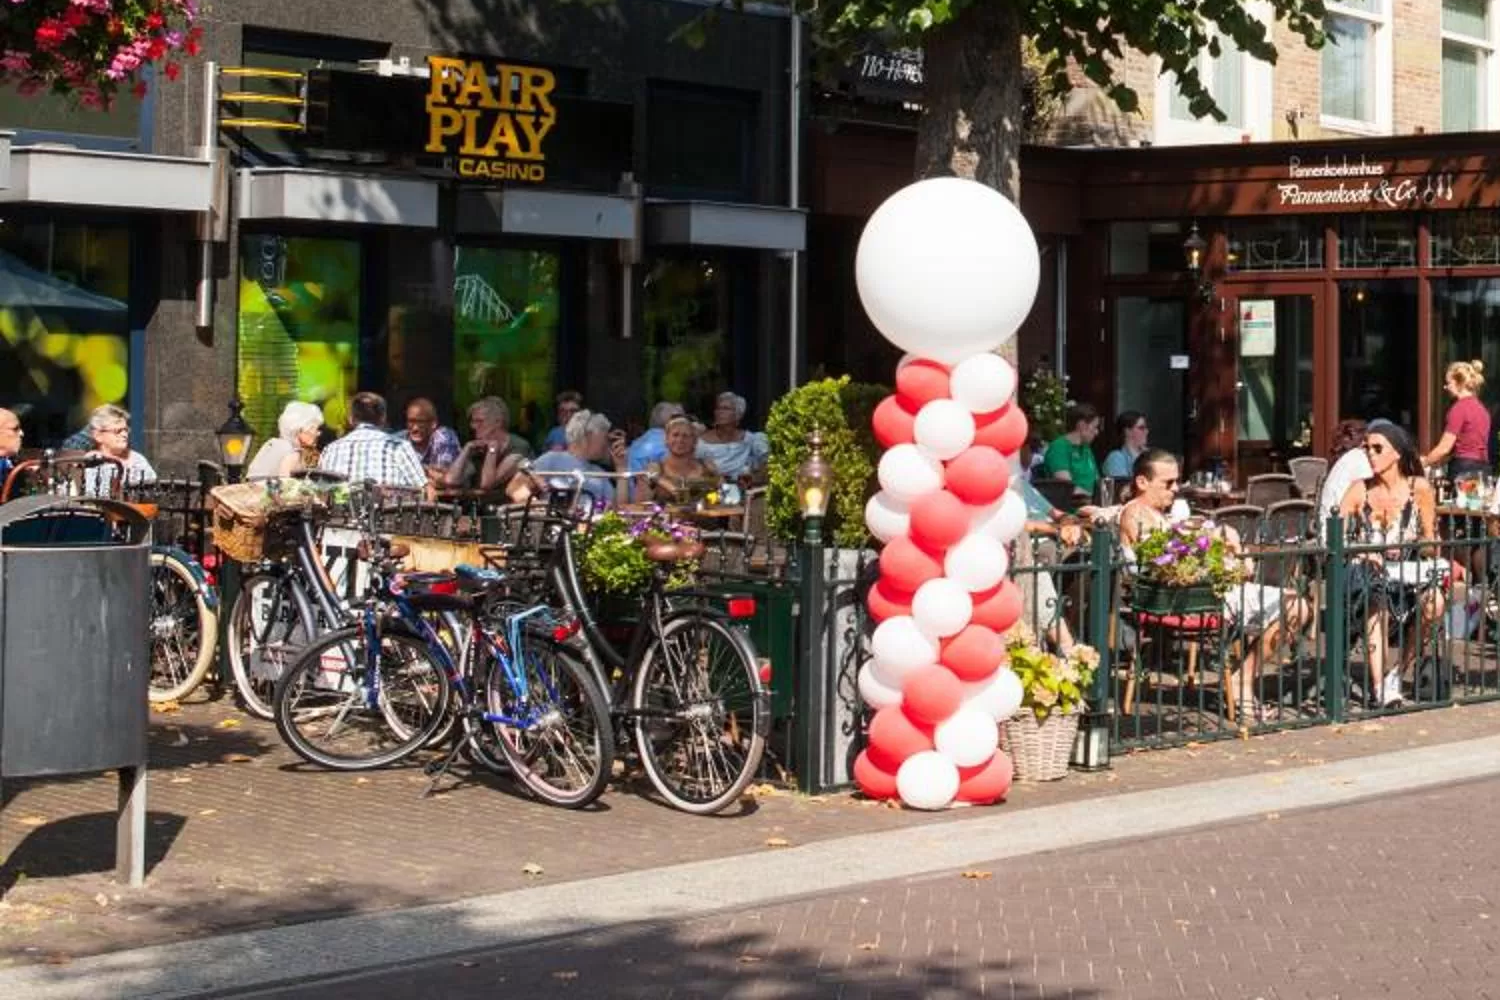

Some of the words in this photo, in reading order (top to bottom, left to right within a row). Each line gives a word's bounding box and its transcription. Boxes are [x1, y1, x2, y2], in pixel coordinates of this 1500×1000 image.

[427, 55, 556, 112] FAIR
[425, 106, 556, 160] PLAY
[459, 157, 545, 181] CASINO
[1374, 179, 1398, 208] &
